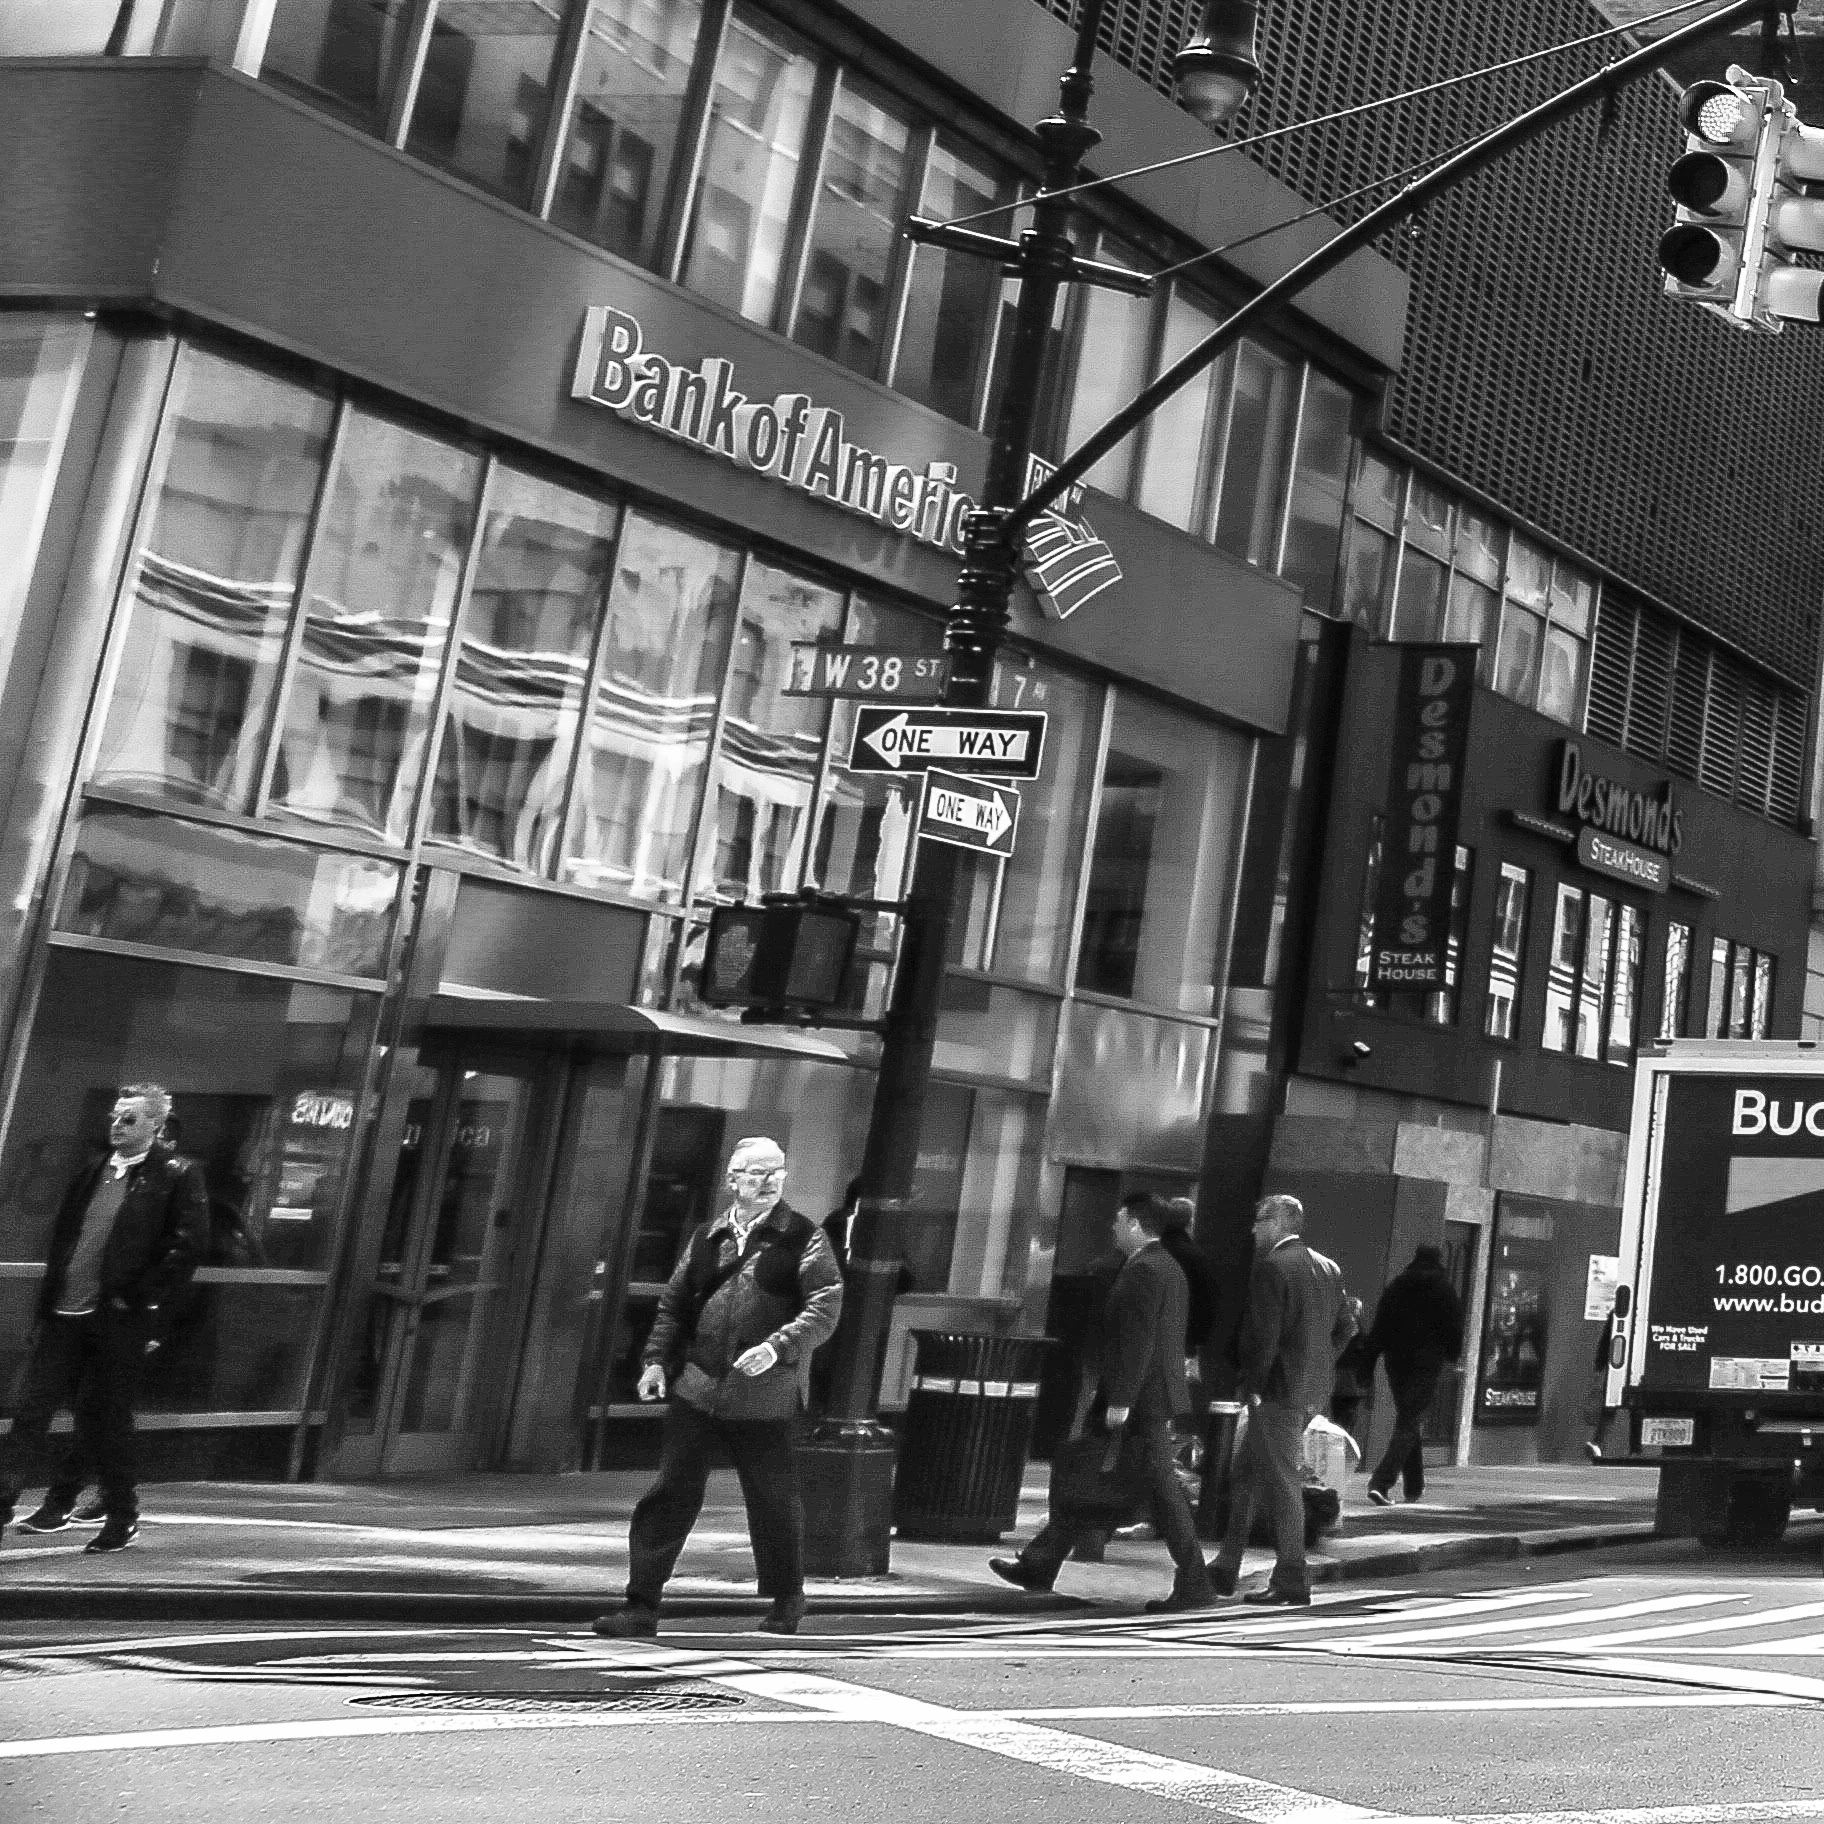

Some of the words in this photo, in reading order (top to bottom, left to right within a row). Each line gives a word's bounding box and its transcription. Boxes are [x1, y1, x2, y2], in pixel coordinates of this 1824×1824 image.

[571, 305, 749, 454] Bank
[746, 392, 812, 483] of
[804, 406, 968, 556] Americ
[824, 651, 852, 690] W
[856, 656, 903, 692] 38
[914, 658, 941, 678] ST
[880, 728, 934, 754] ONE
[958, 730, 1018, 758] WAY
[936, 792, 966, 824] ONE
[975, 800, 1004, 832] WAY
[1376, 967, 1438, 982] HOUSE
[1378, 951, 1436, 966] STEAK
